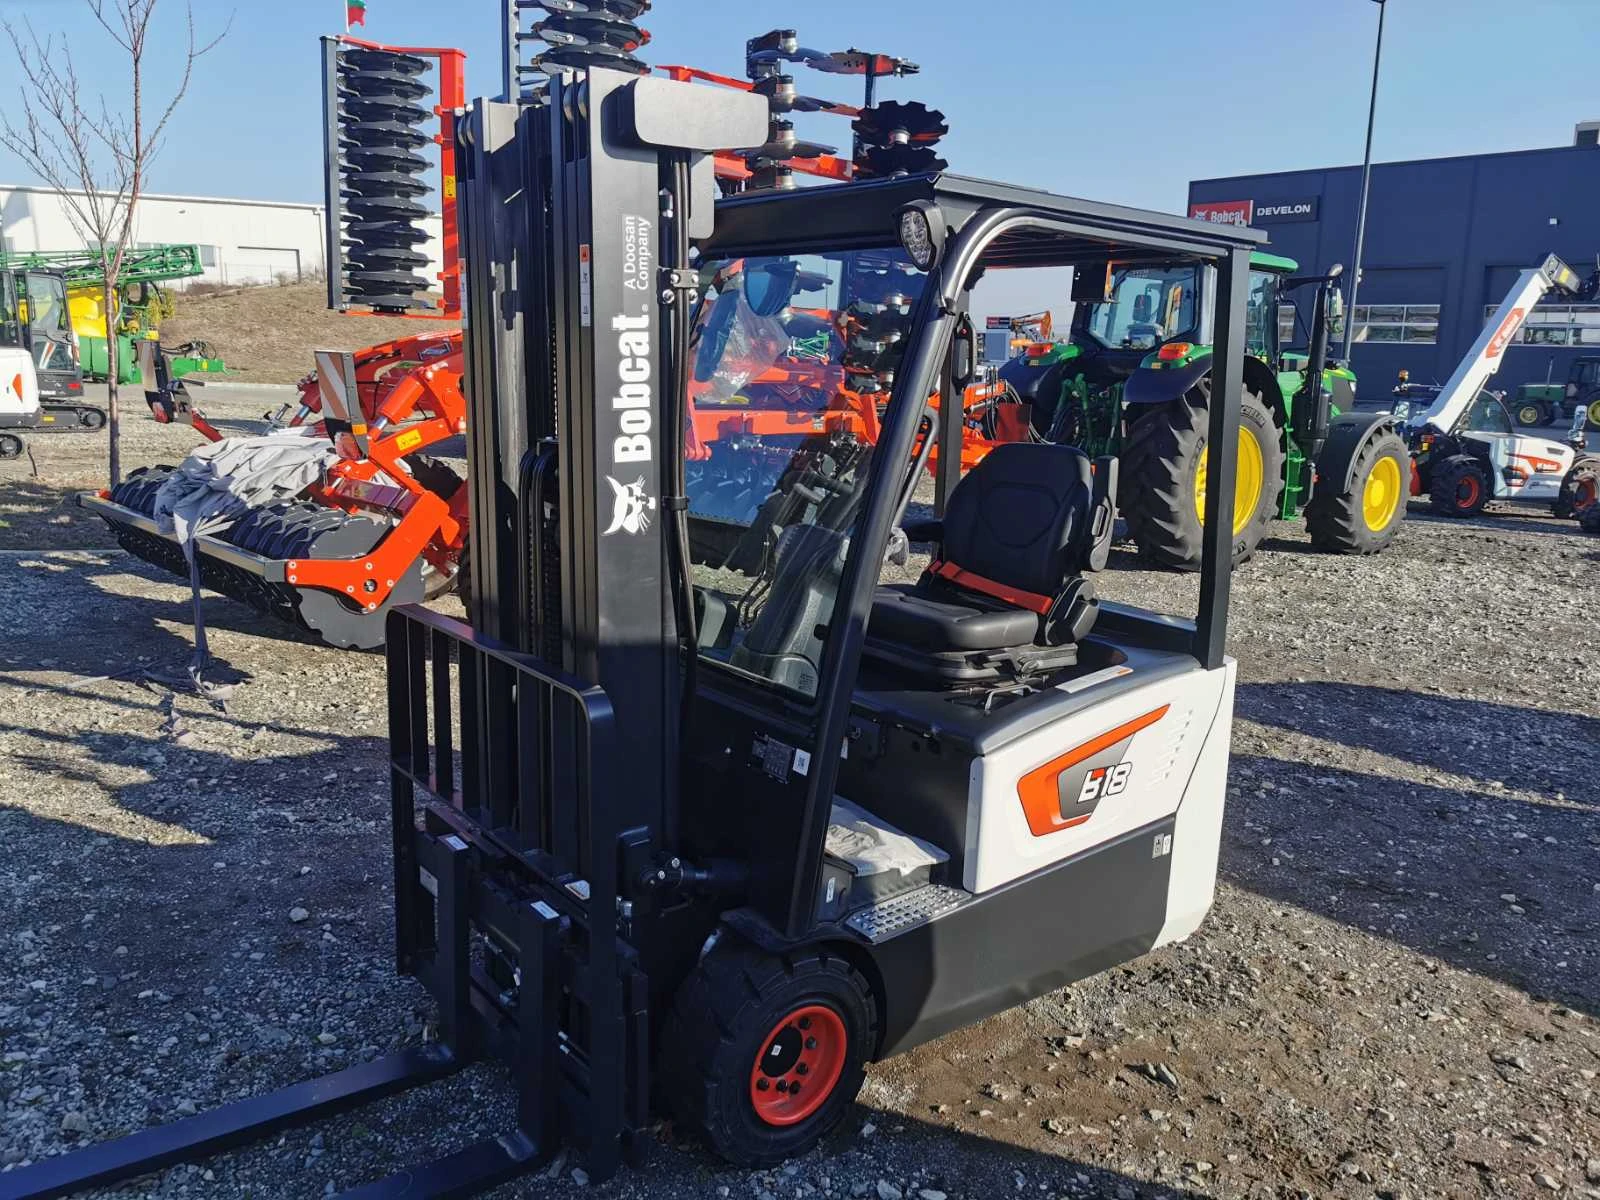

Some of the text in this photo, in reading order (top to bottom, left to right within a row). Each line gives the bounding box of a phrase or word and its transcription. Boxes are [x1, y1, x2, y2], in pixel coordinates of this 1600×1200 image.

[1210, 209, 1245, 224] Bobcat
[1257, 204, 1311, 217] DEVELON
[622, 216, 636, 290] A Doosan
[636, 216, 653, 290] Company
